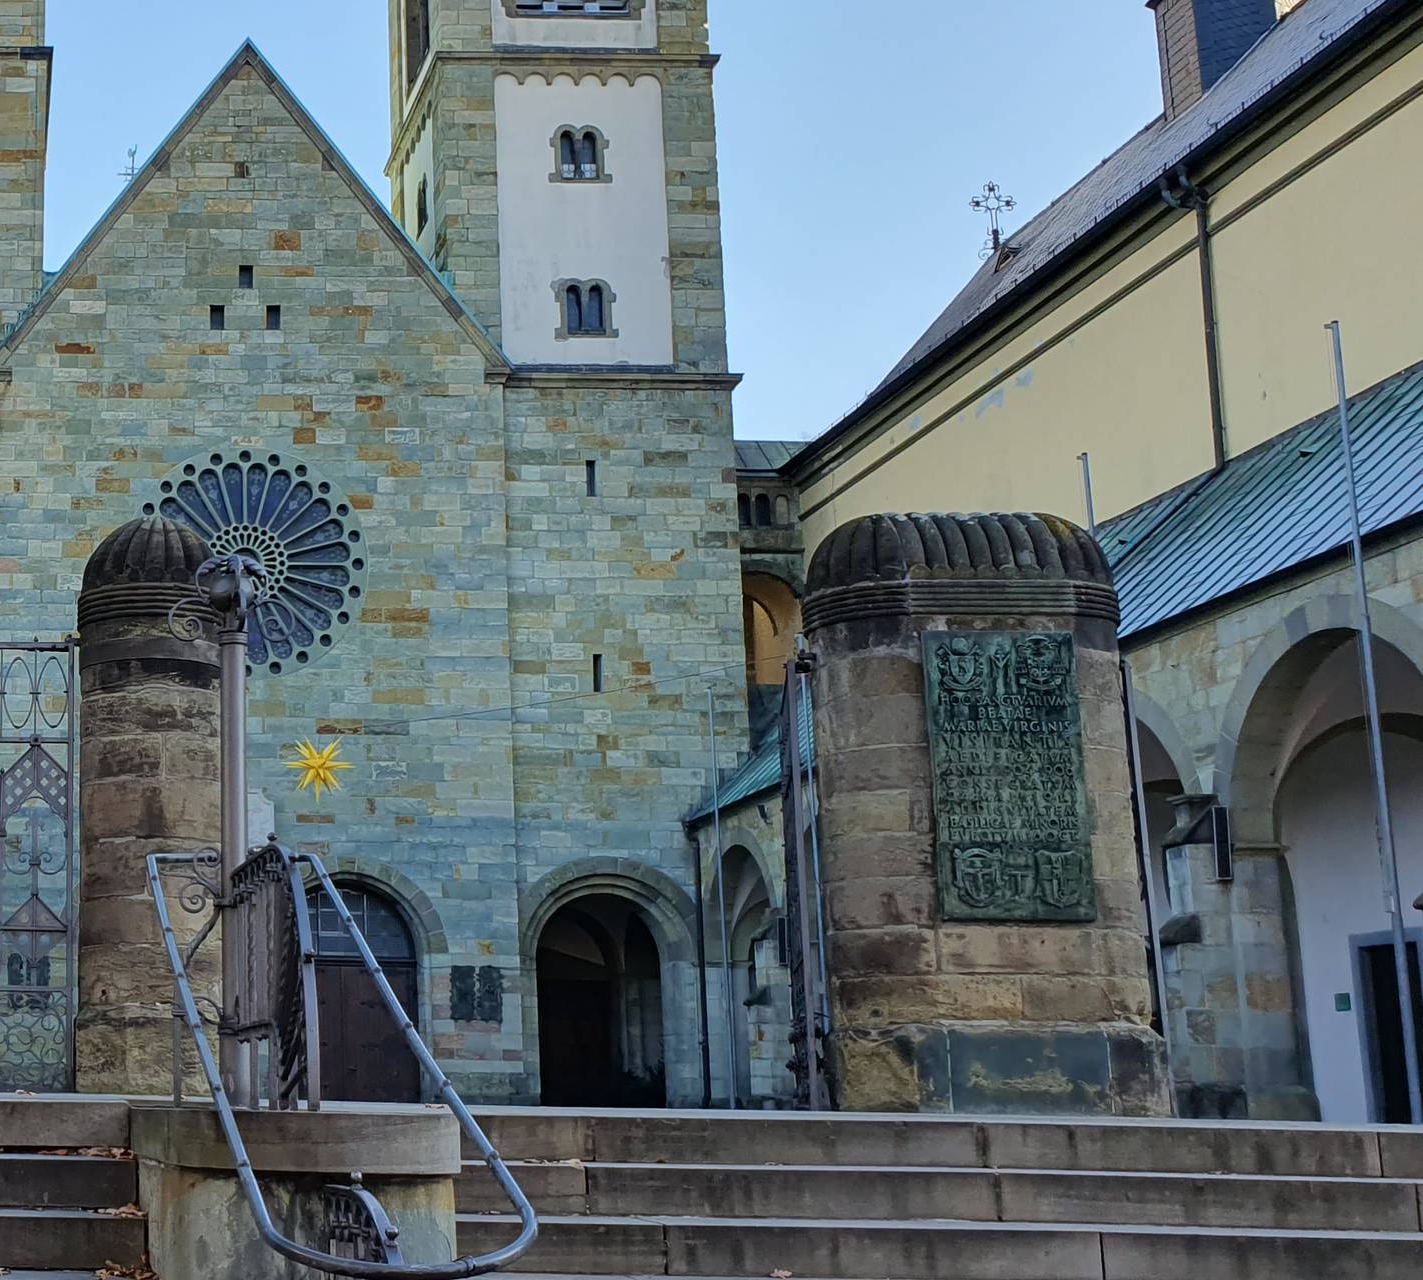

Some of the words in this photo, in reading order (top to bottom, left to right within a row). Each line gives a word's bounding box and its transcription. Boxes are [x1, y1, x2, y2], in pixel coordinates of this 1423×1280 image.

[939, 692, 971, 706] HOC
[976, 694, 1069, 706] SANCTVARIVM
[978, 707, 1032, 719] BEATAE
[943, 720, 1000, 732] MARIAE
[1001, 720, 1072, 733] VIRGINIS
[942, 733, 1072, 750] VISITANTIS
[946, 750, 1072, 763] AEDIFICATVM
[949, 816, 1020, 829] BASILICAE
